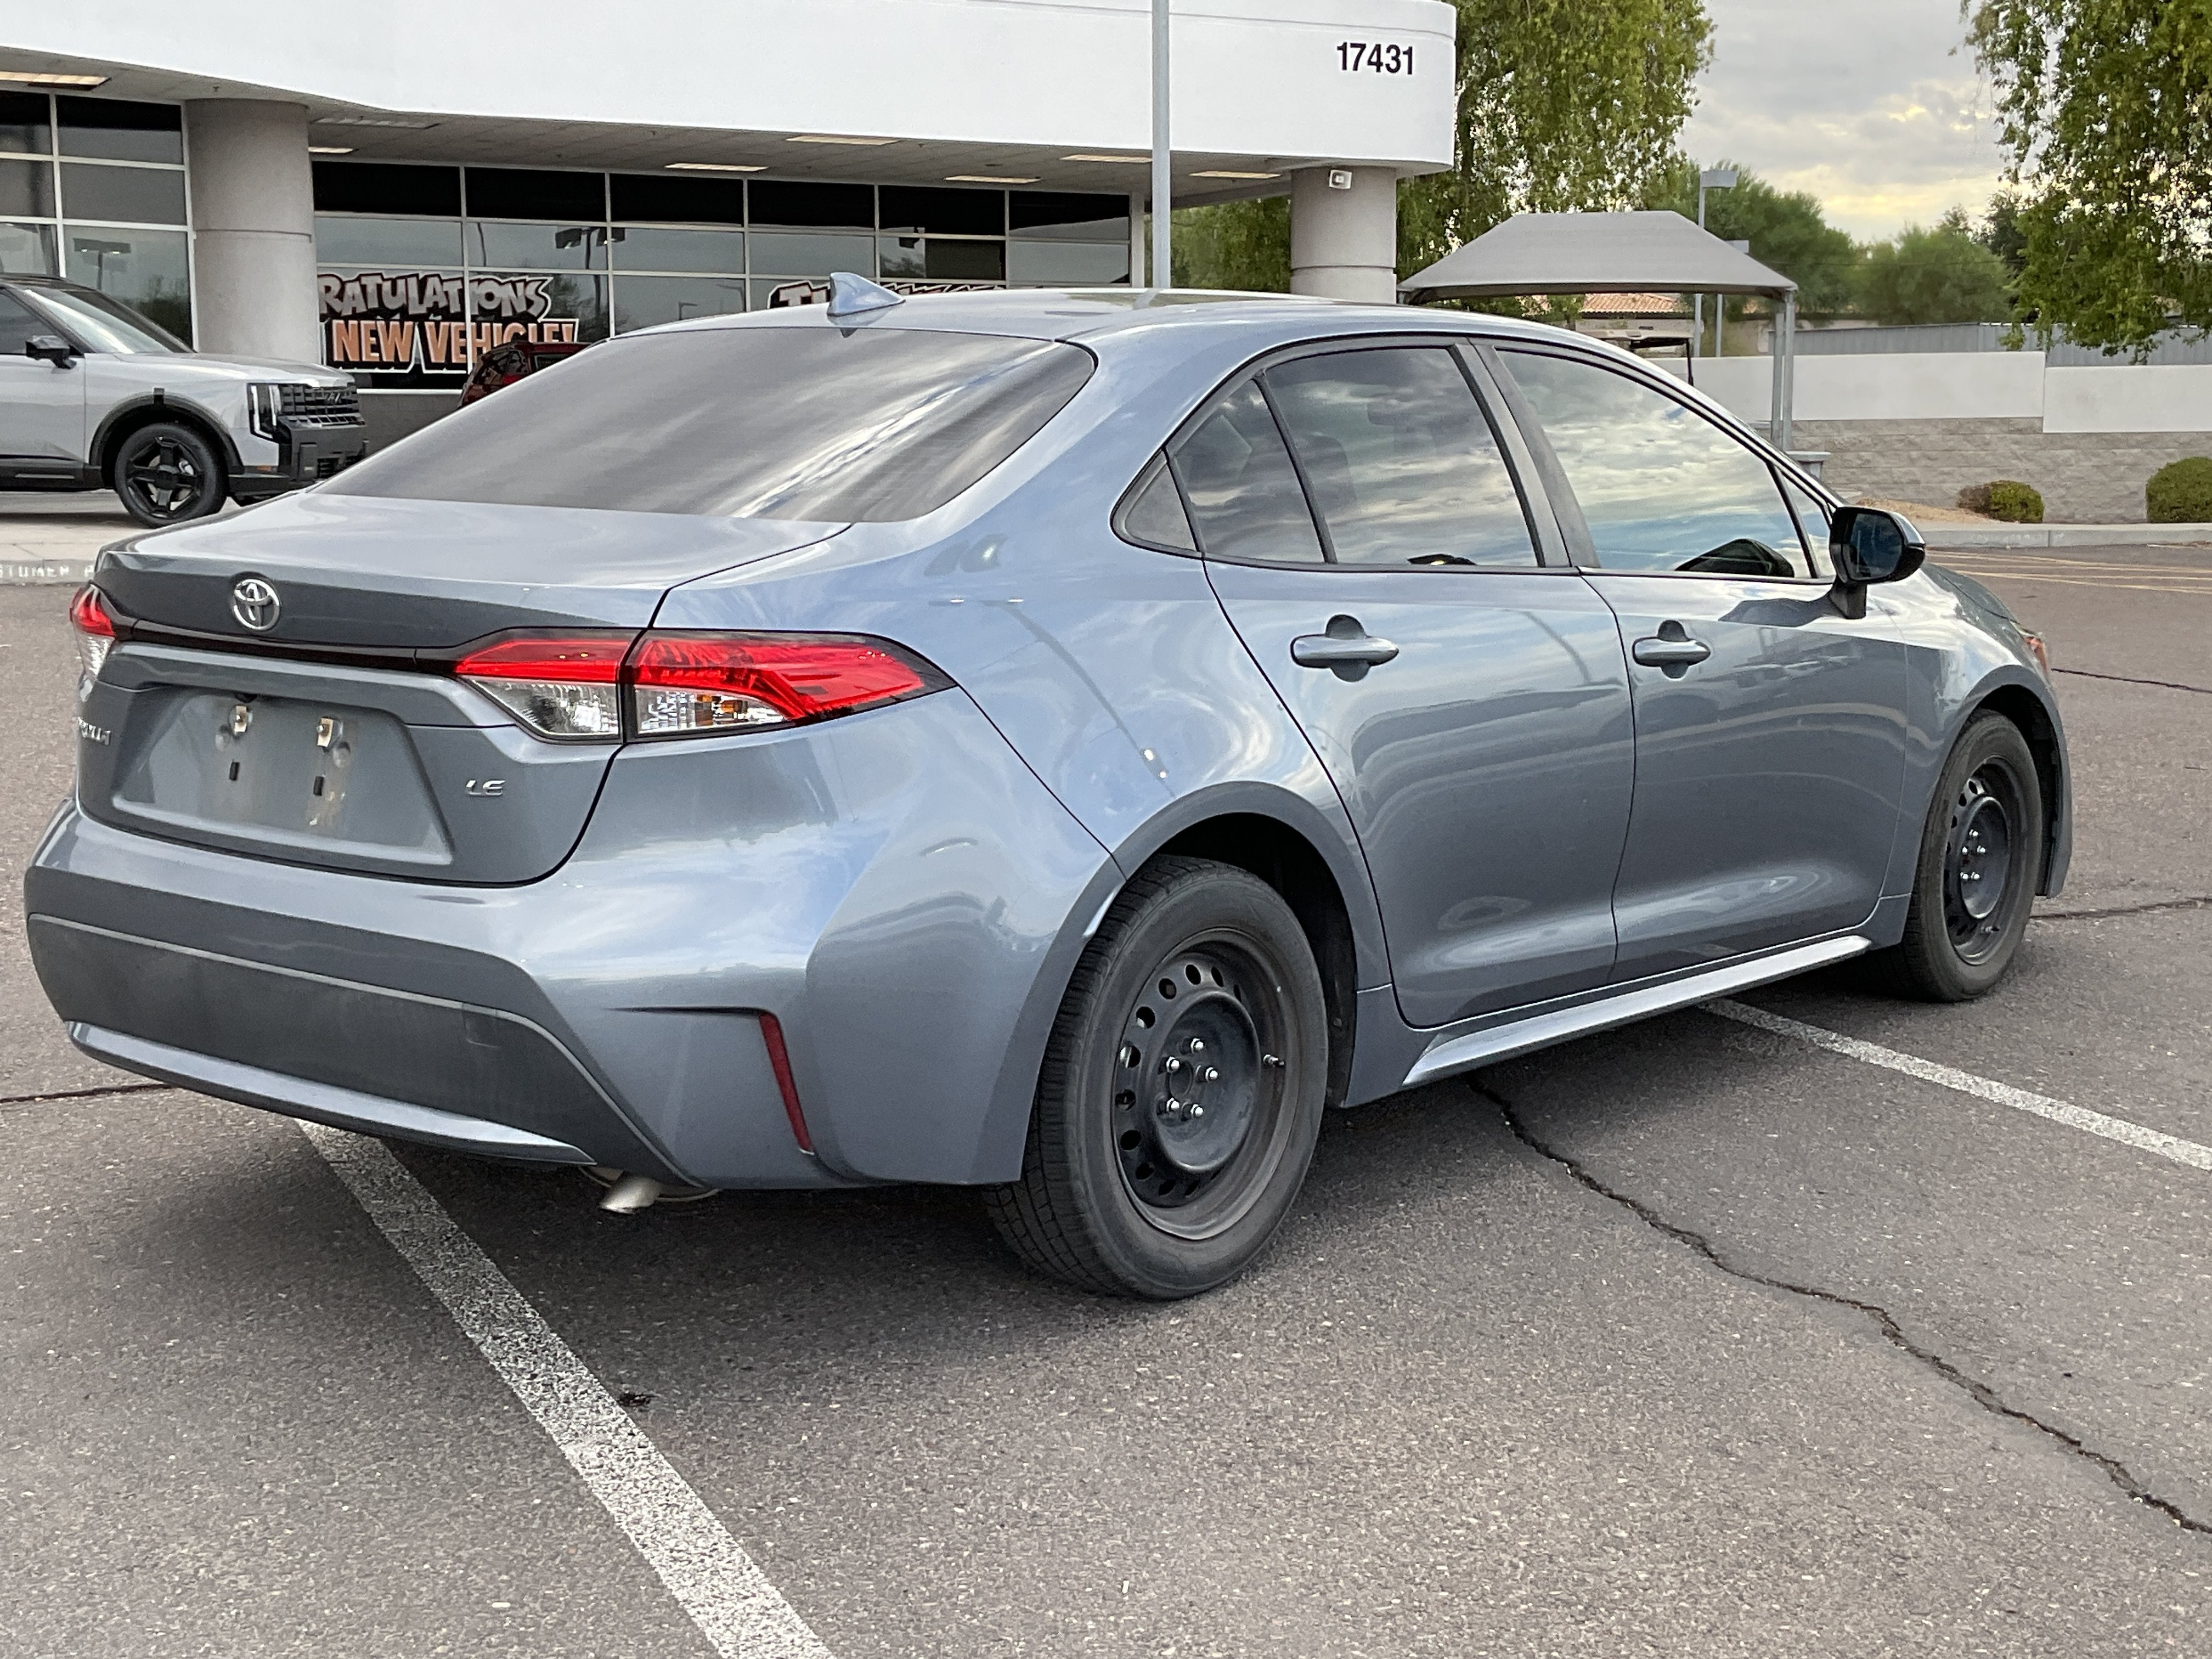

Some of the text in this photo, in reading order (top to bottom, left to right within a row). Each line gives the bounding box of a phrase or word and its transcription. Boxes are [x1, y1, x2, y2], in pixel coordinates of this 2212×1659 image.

[1336, 42, 1413, 75] 17431
[332, 319, 413, 362] NEW
[465, 780, 505, 796] LE
